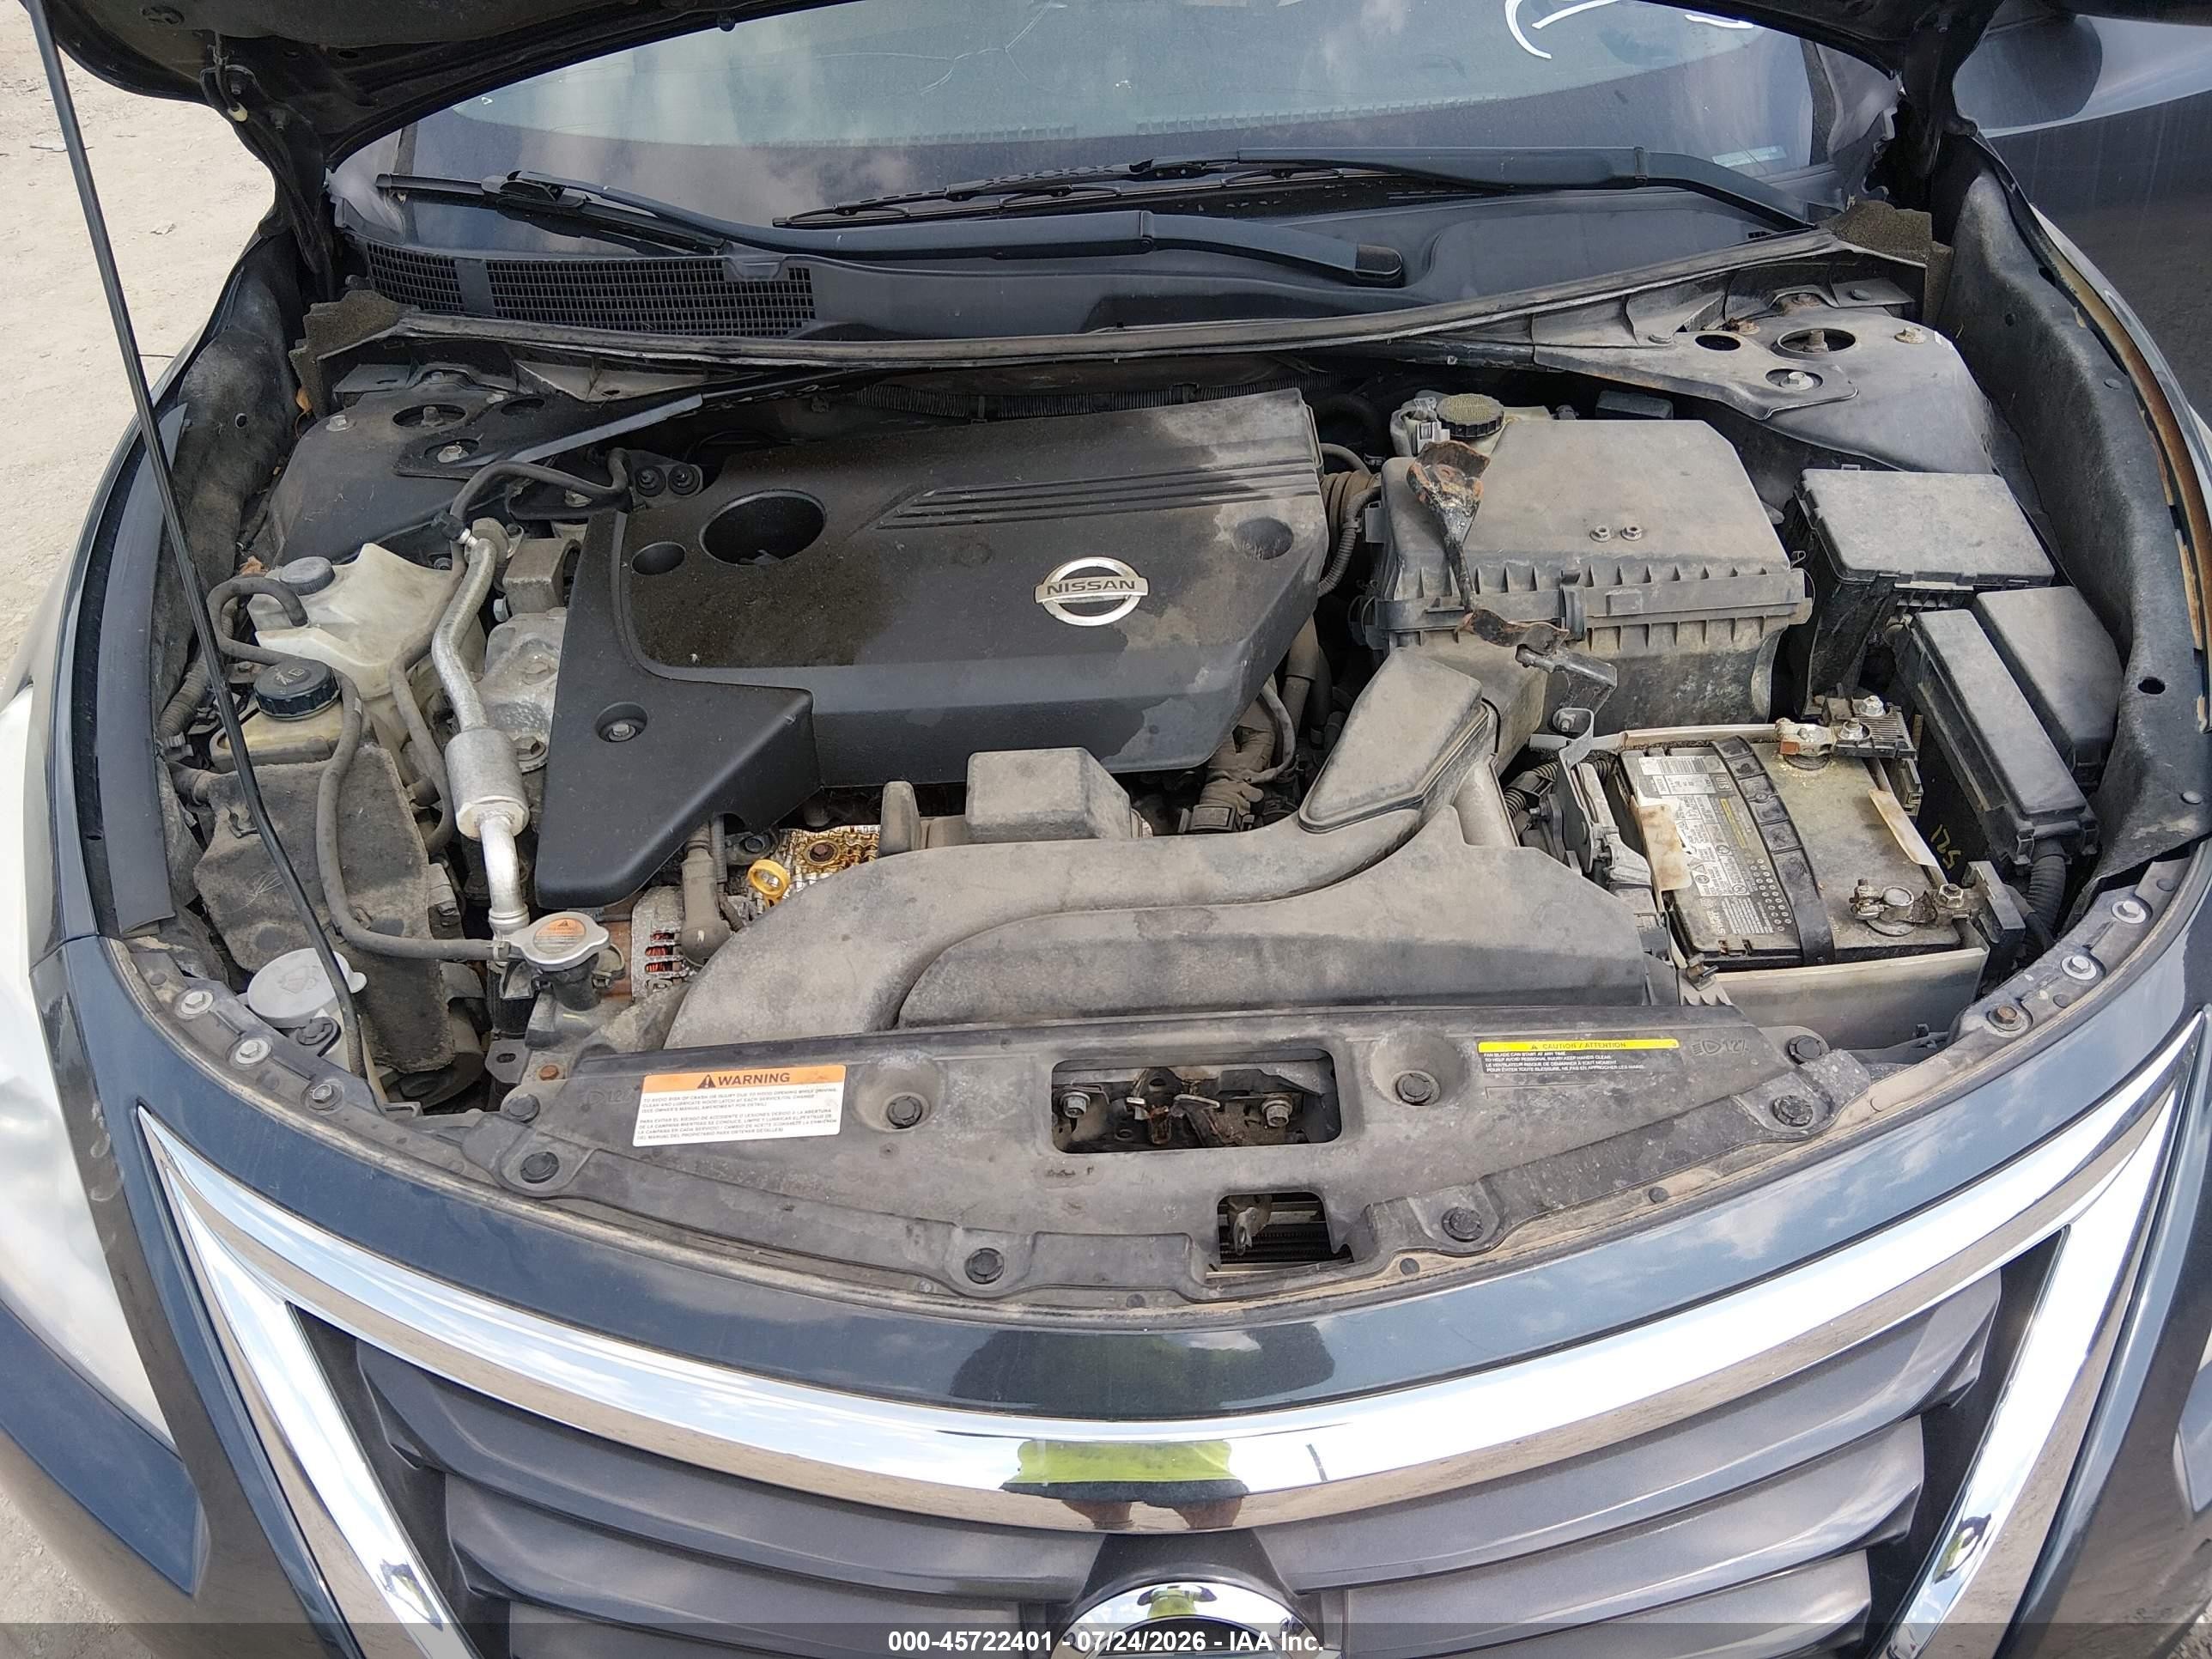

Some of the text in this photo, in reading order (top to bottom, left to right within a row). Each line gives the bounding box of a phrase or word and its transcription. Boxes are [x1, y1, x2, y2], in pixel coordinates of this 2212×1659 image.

[1048, 580, 1135, 595] NISSAN
[1713, 911, 1726, 934] START
[718, 1073, 790, 1085] WARNING
